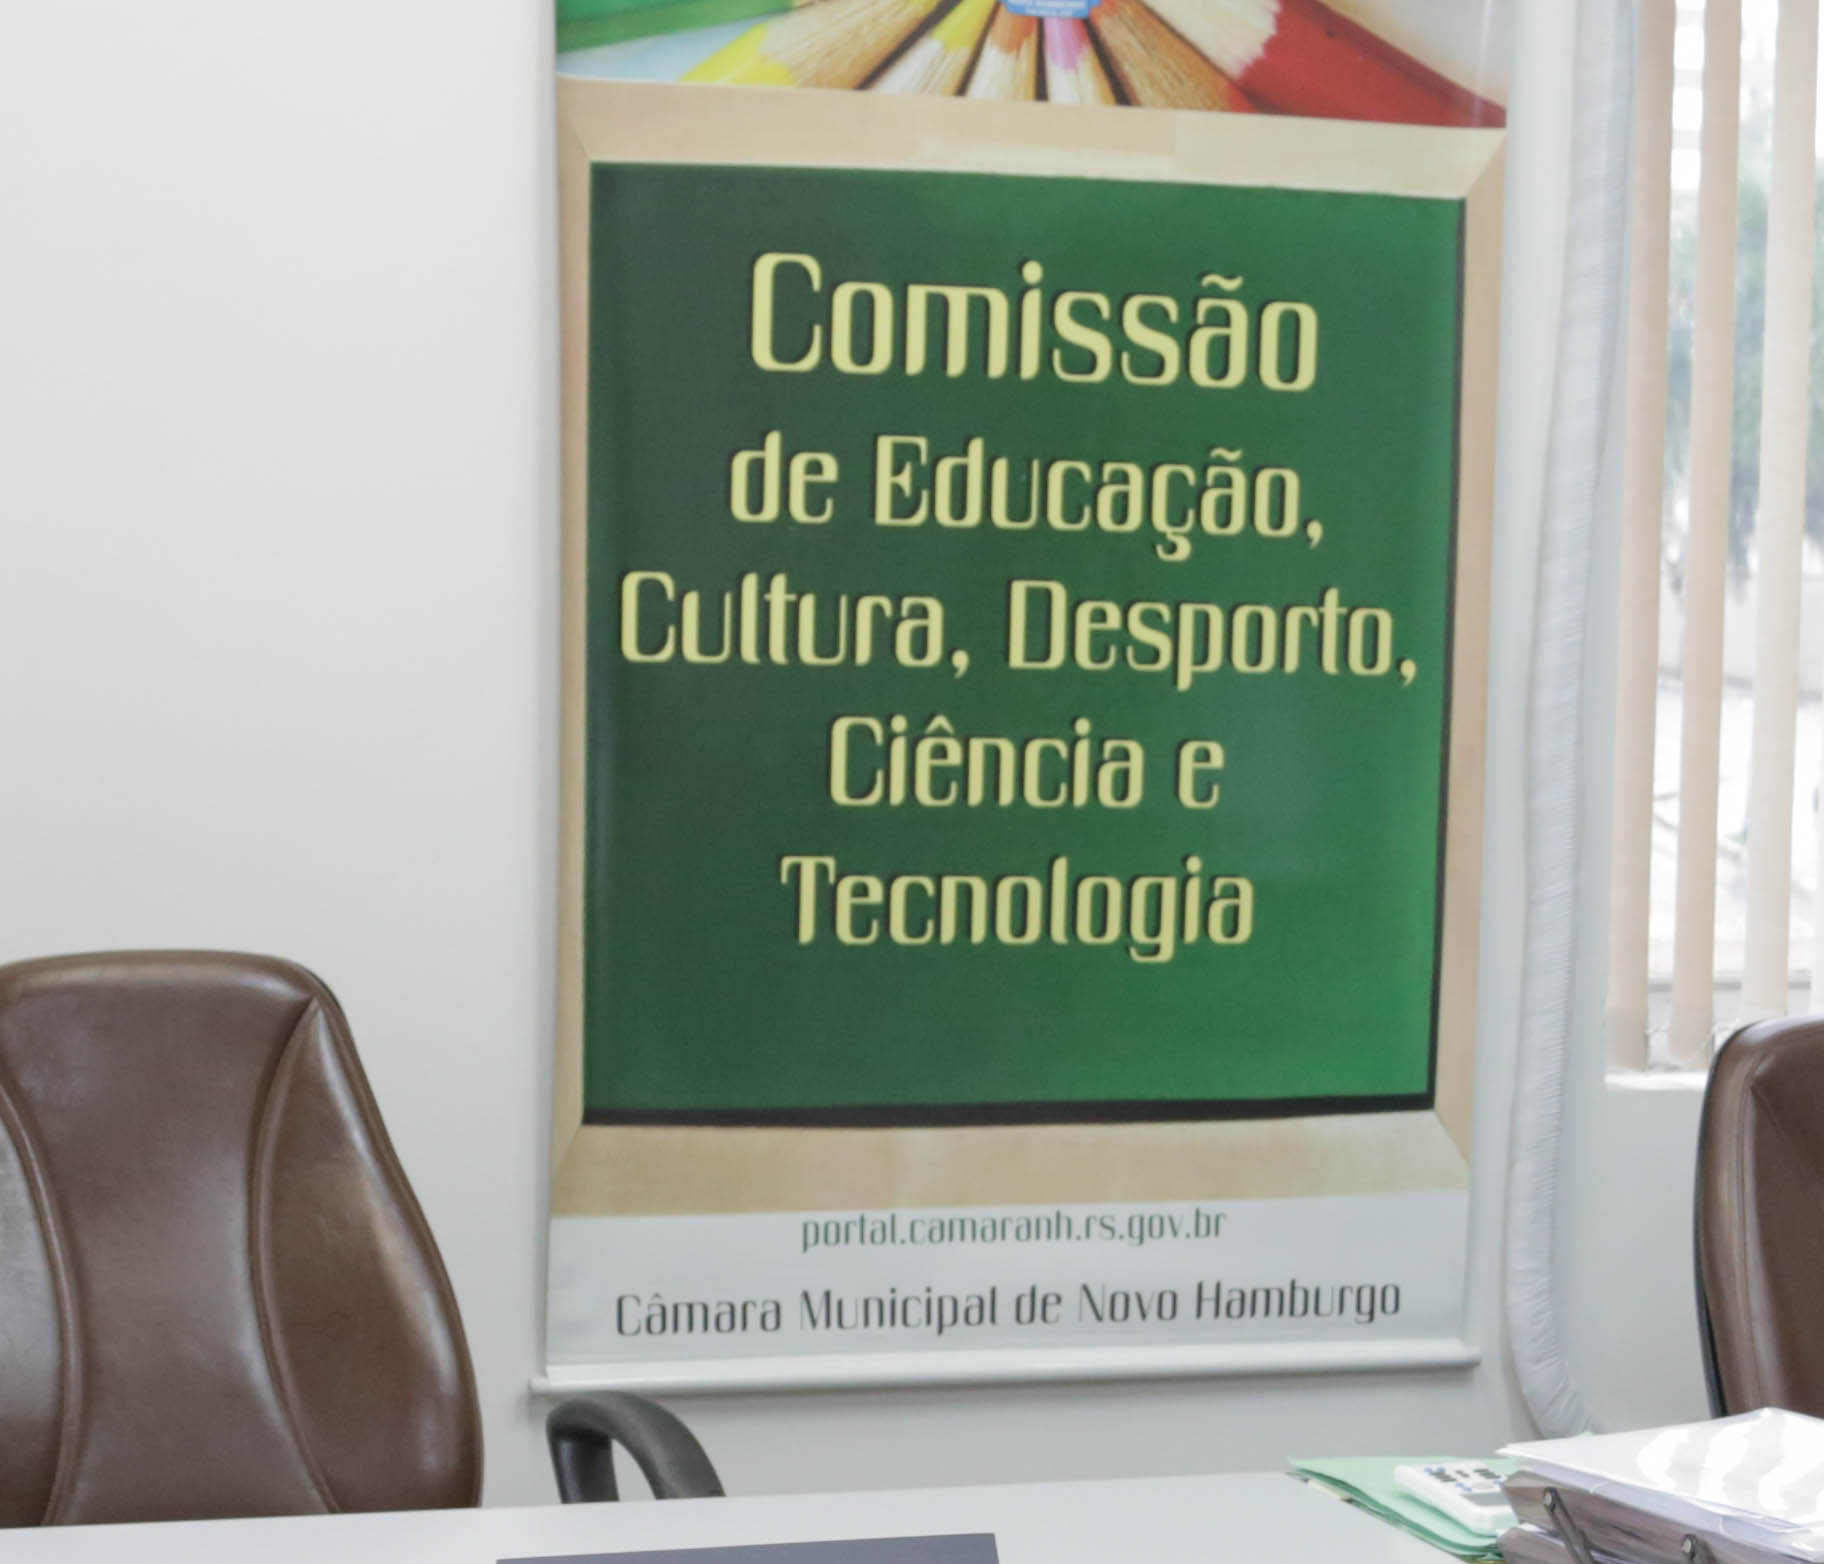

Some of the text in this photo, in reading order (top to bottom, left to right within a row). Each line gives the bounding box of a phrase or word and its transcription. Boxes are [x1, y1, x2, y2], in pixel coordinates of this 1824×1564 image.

[750, 252, 1320, 392] Comissão
[729, 430, 1324, 561] de Educação,
[620, 570, 1419, 692] Cultura, Desporto,
[828, 714, 1226, 810] Ciência e
[781, 853, 1255, 964] Tecnologia
[801, 1206, 1227, 1254] portal.camaranh.rs.gov.br
[615, 1277, 1403, 1338] Câmara Municipal de Novo Hamburgo
